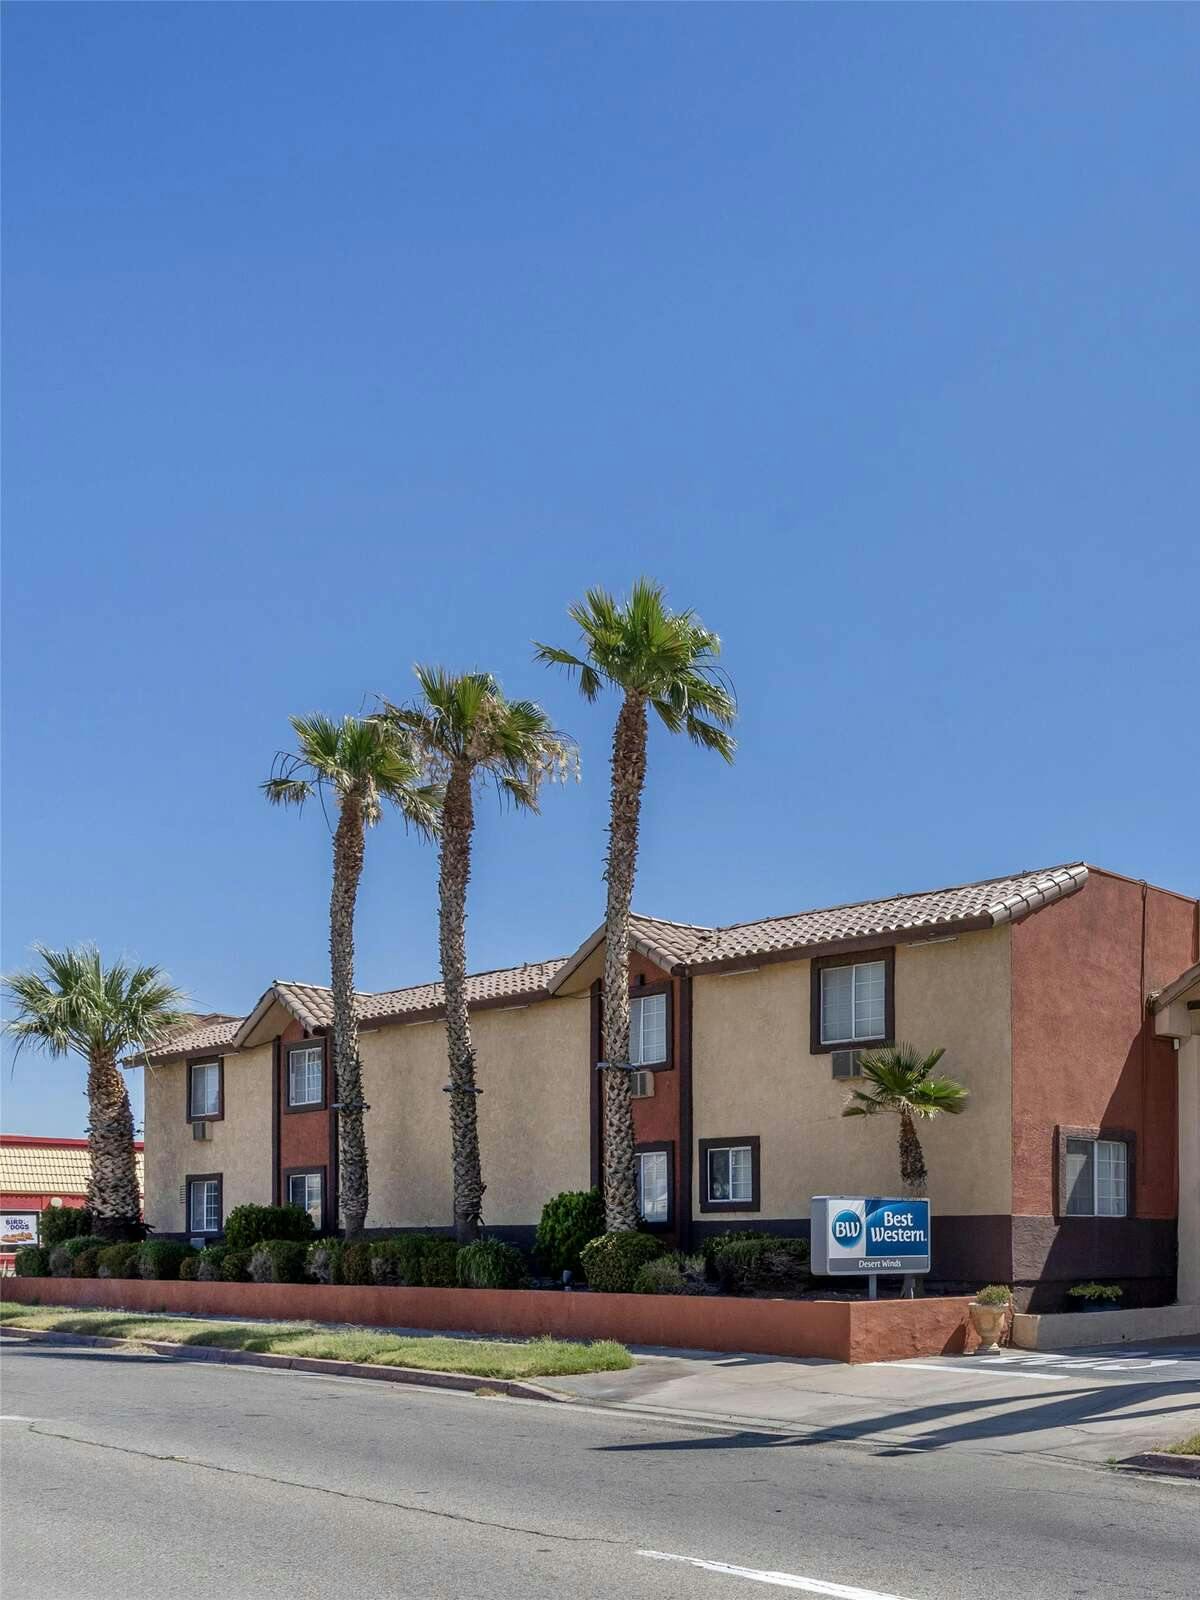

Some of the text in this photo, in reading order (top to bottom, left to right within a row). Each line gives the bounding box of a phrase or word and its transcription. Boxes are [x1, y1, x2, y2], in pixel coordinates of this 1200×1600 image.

[884, 1211, 913, 1227] Best
[835, 1221, 860, 1238] BW
[858, 1260, 901, 1268] Desert Winds
